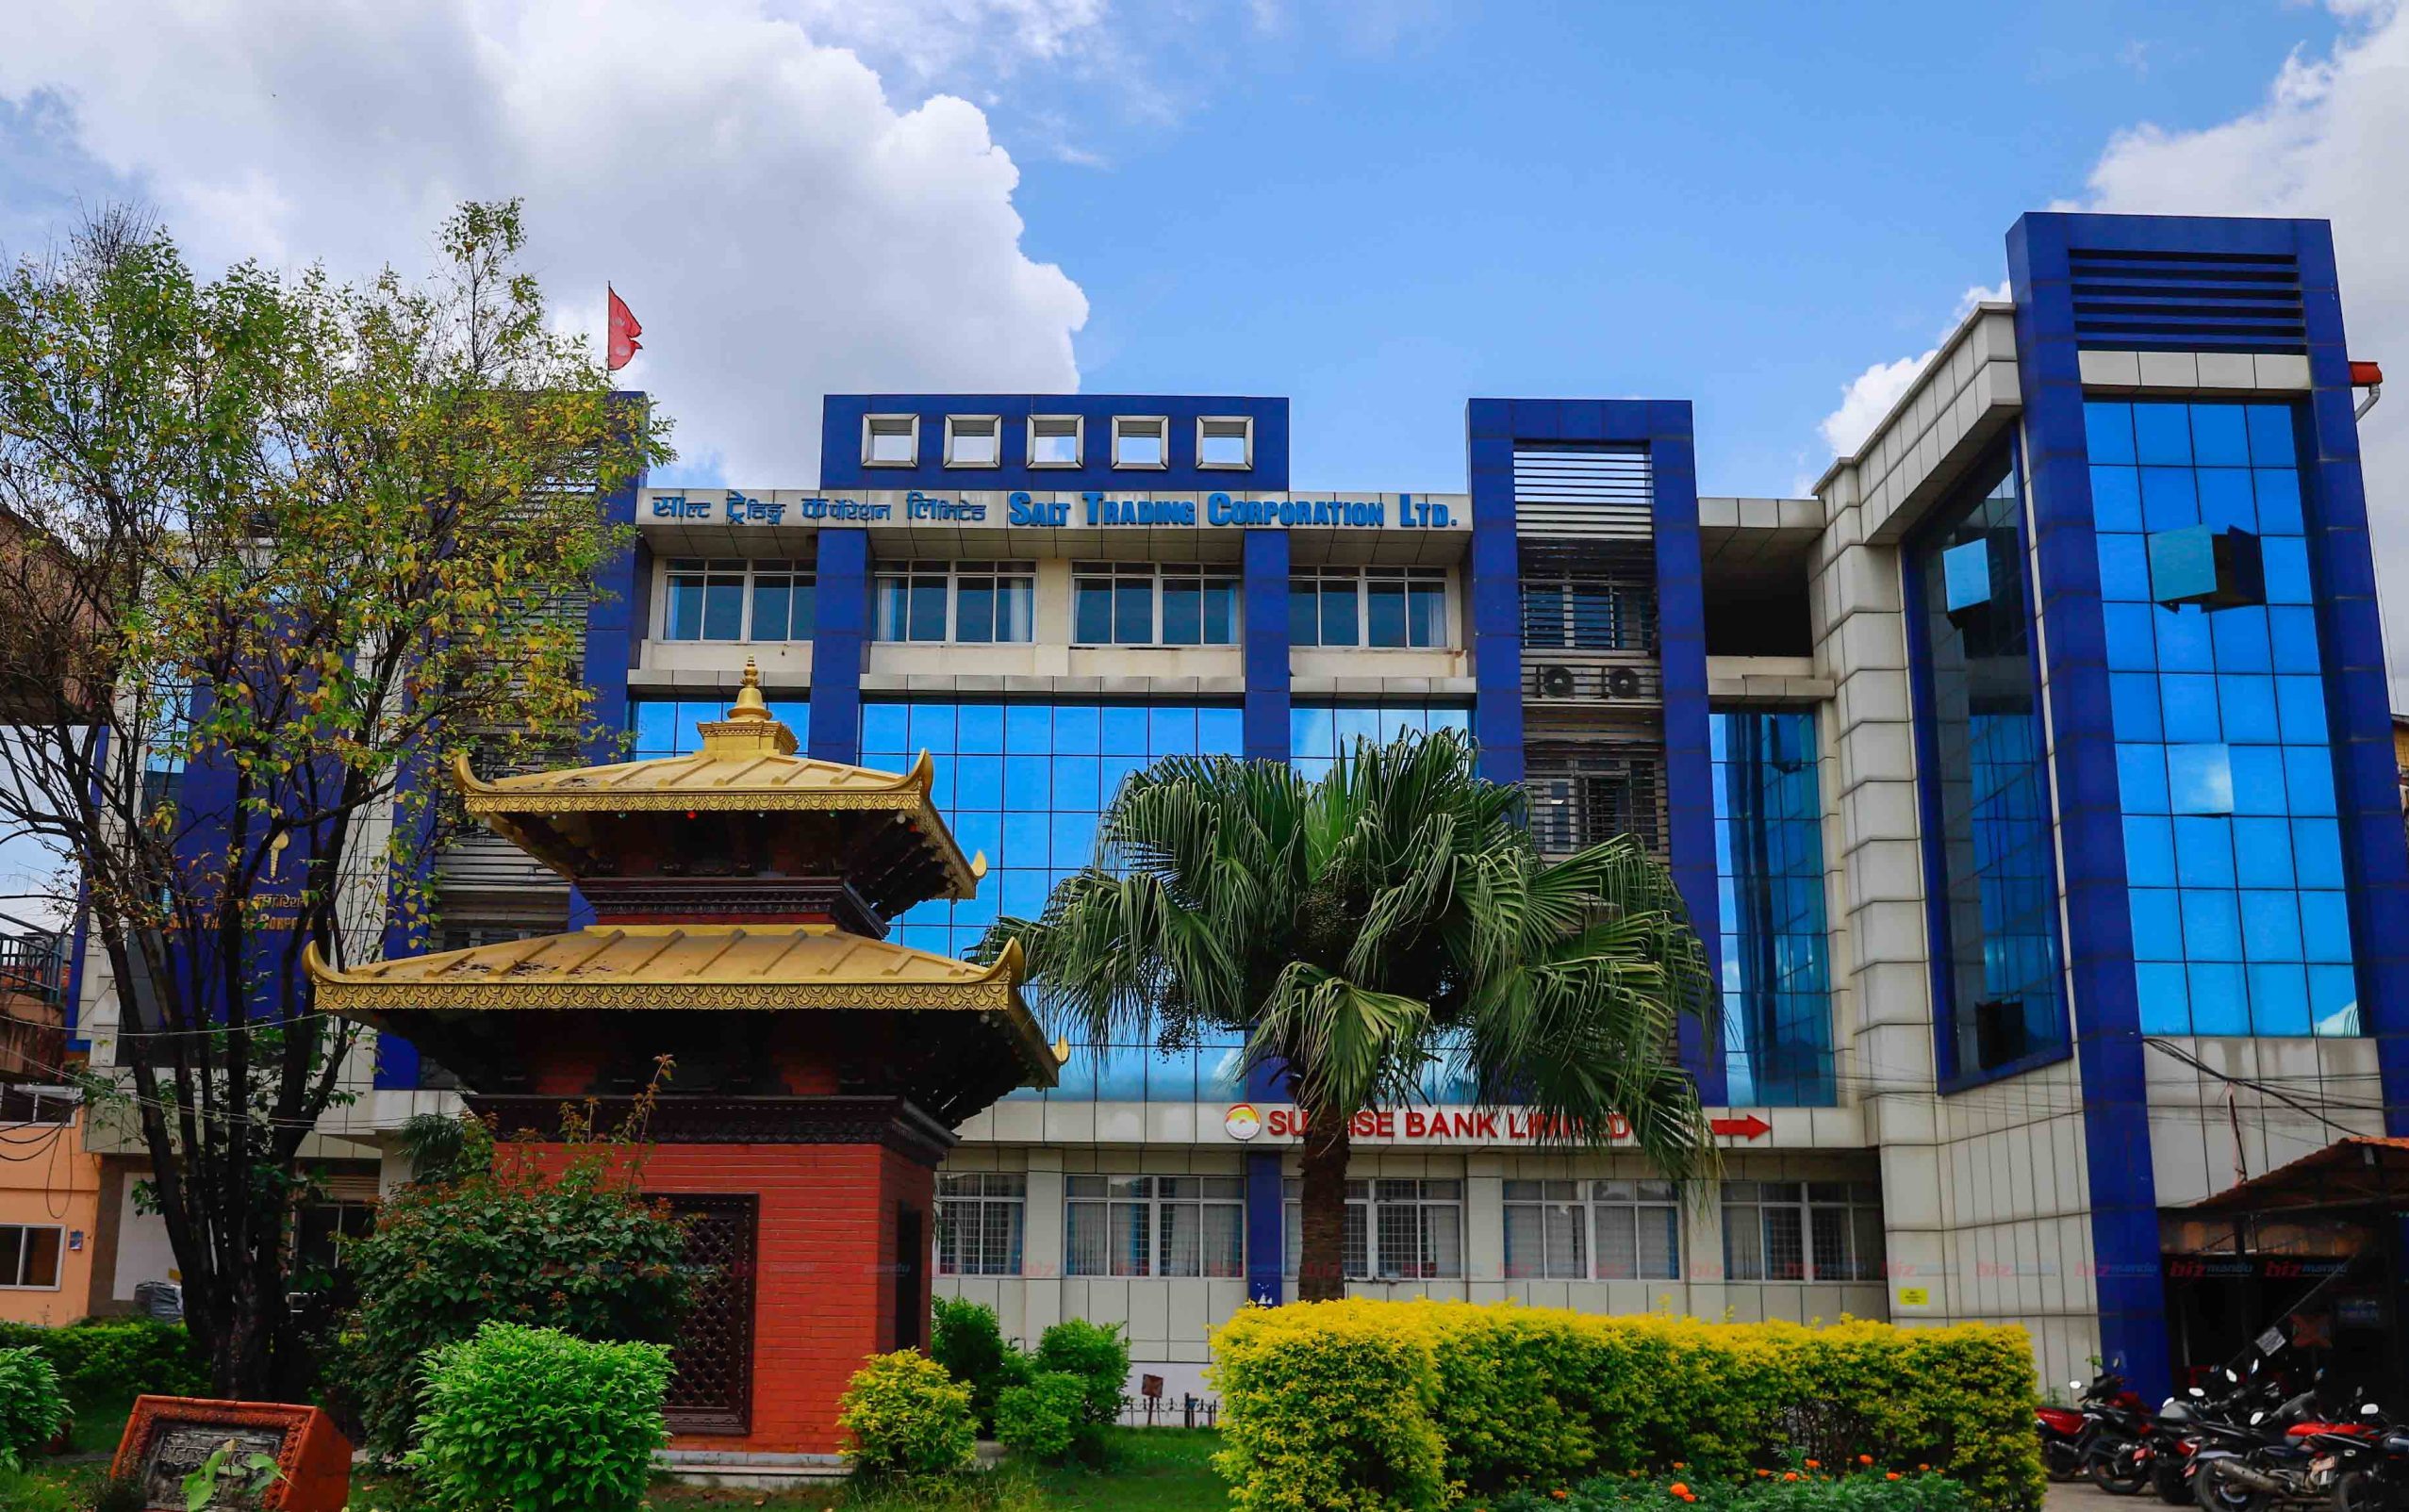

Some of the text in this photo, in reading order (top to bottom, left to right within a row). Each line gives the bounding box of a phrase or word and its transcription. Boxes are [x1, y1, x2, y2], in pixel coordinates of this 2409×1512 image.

[652, 496, 711, 518] साल्ट
[906, 490, 987, 521] लिमिटेड
[1008, 491, 1458, 527] SALT TRADING CORPORATION LTD.
[1267, 1109, 1394, 1137] SUISE
[1405, 1111, 1498, 1138] BANK
